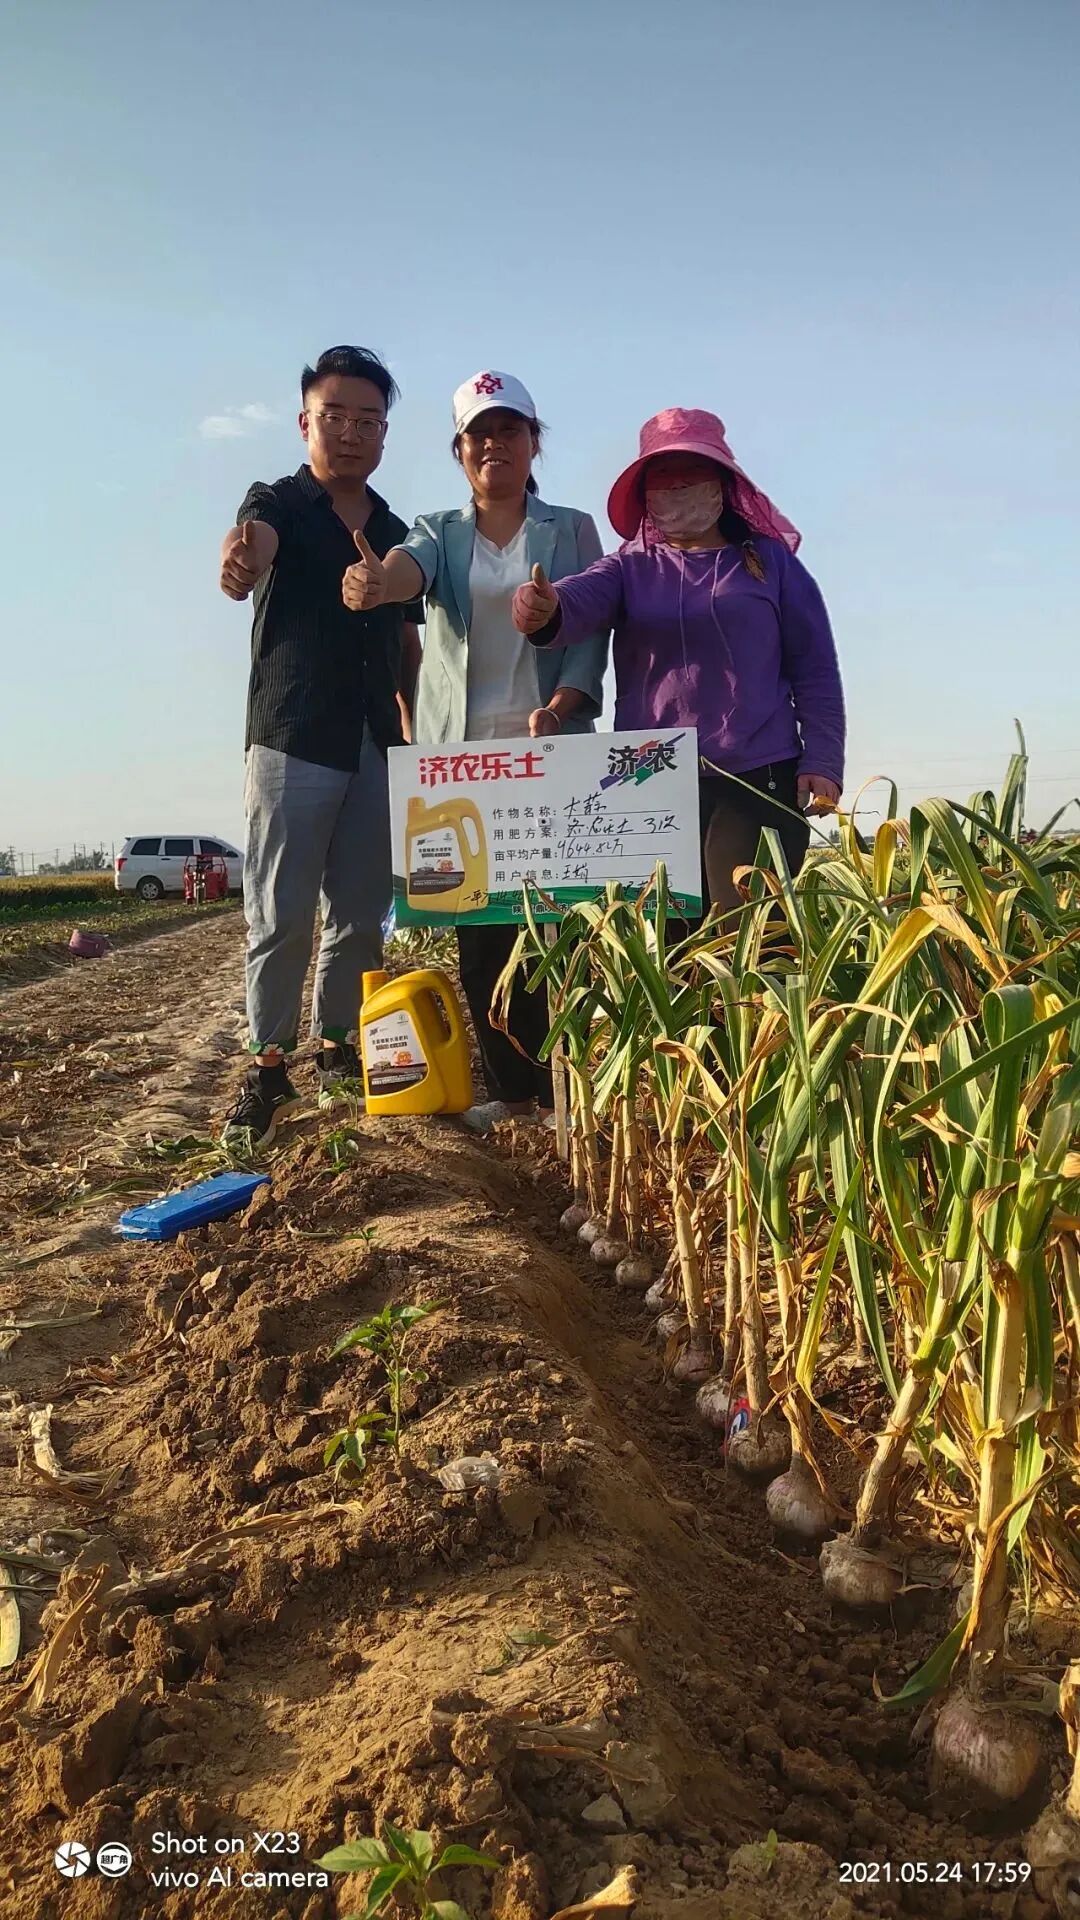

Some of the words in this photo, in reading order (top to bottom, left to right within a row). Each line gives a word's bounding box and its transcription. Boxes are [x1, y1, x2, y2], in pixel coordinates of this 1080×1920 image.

[419, 751, 545, 788] 济农乐土
[607, 743, 678, 775] 济农
